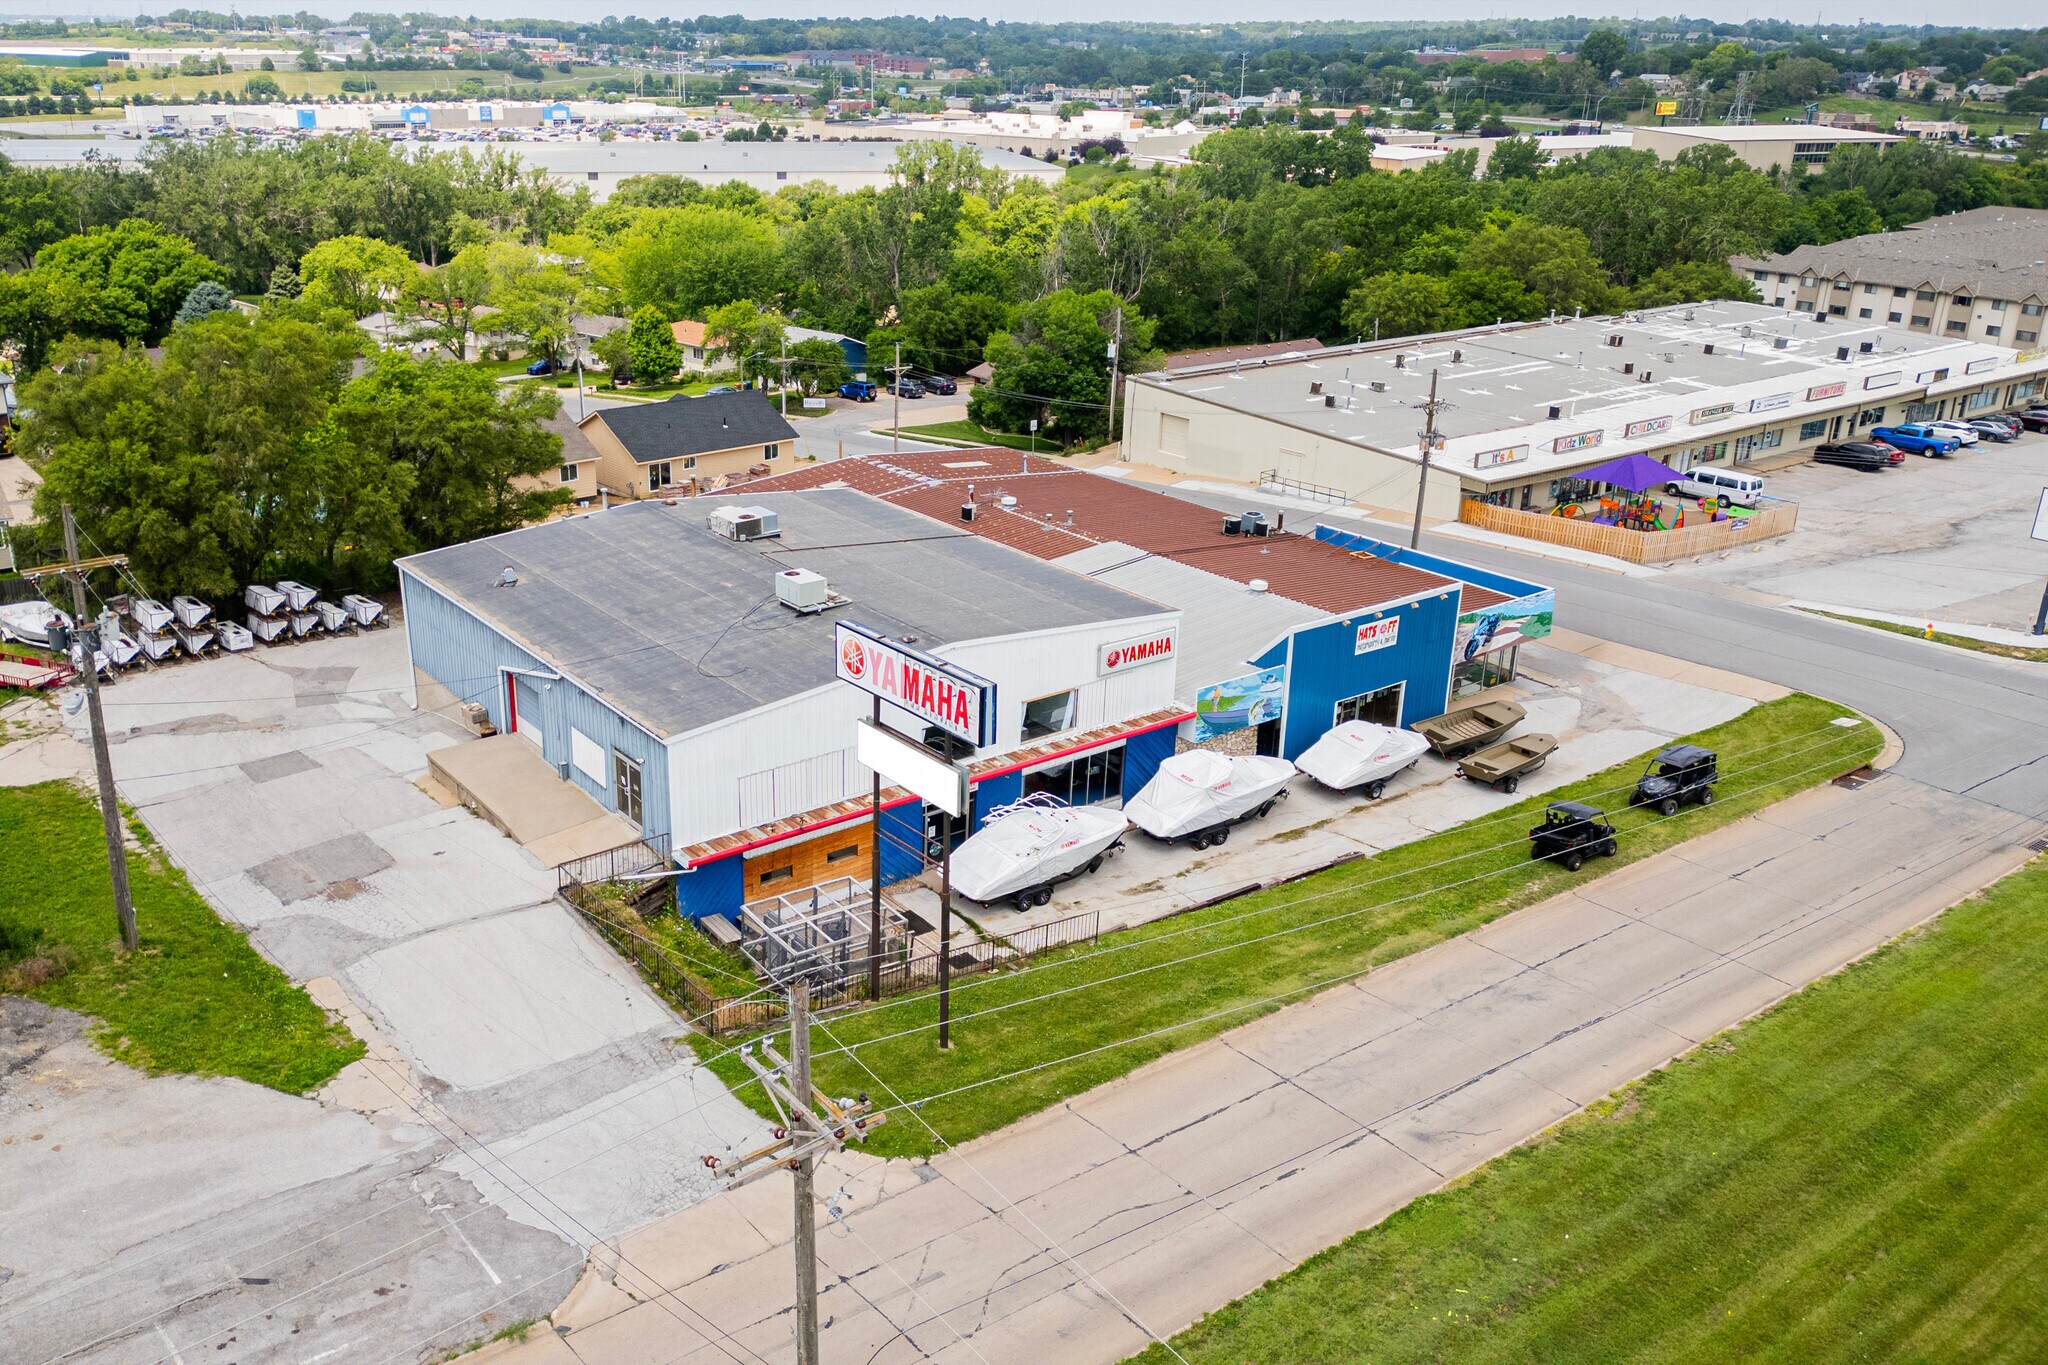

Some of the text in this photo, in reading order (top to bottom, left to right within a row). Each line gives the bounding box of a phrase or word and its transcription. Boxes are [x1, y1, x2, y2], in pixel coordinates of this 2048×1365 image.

[1812, 384, 1844, 398] FURNITURE
[1630, 419, 1670, 435] CHILDCARE
[1558, 431, 1602, 450] Kidz World
[1492, 449, 1514, 464] It's A
[1358, 619, 1398, 641] HATS OFF
[1122, 637, 1171, 664] YAMAHA
[868, 646, 969, 730] YAMAHA
